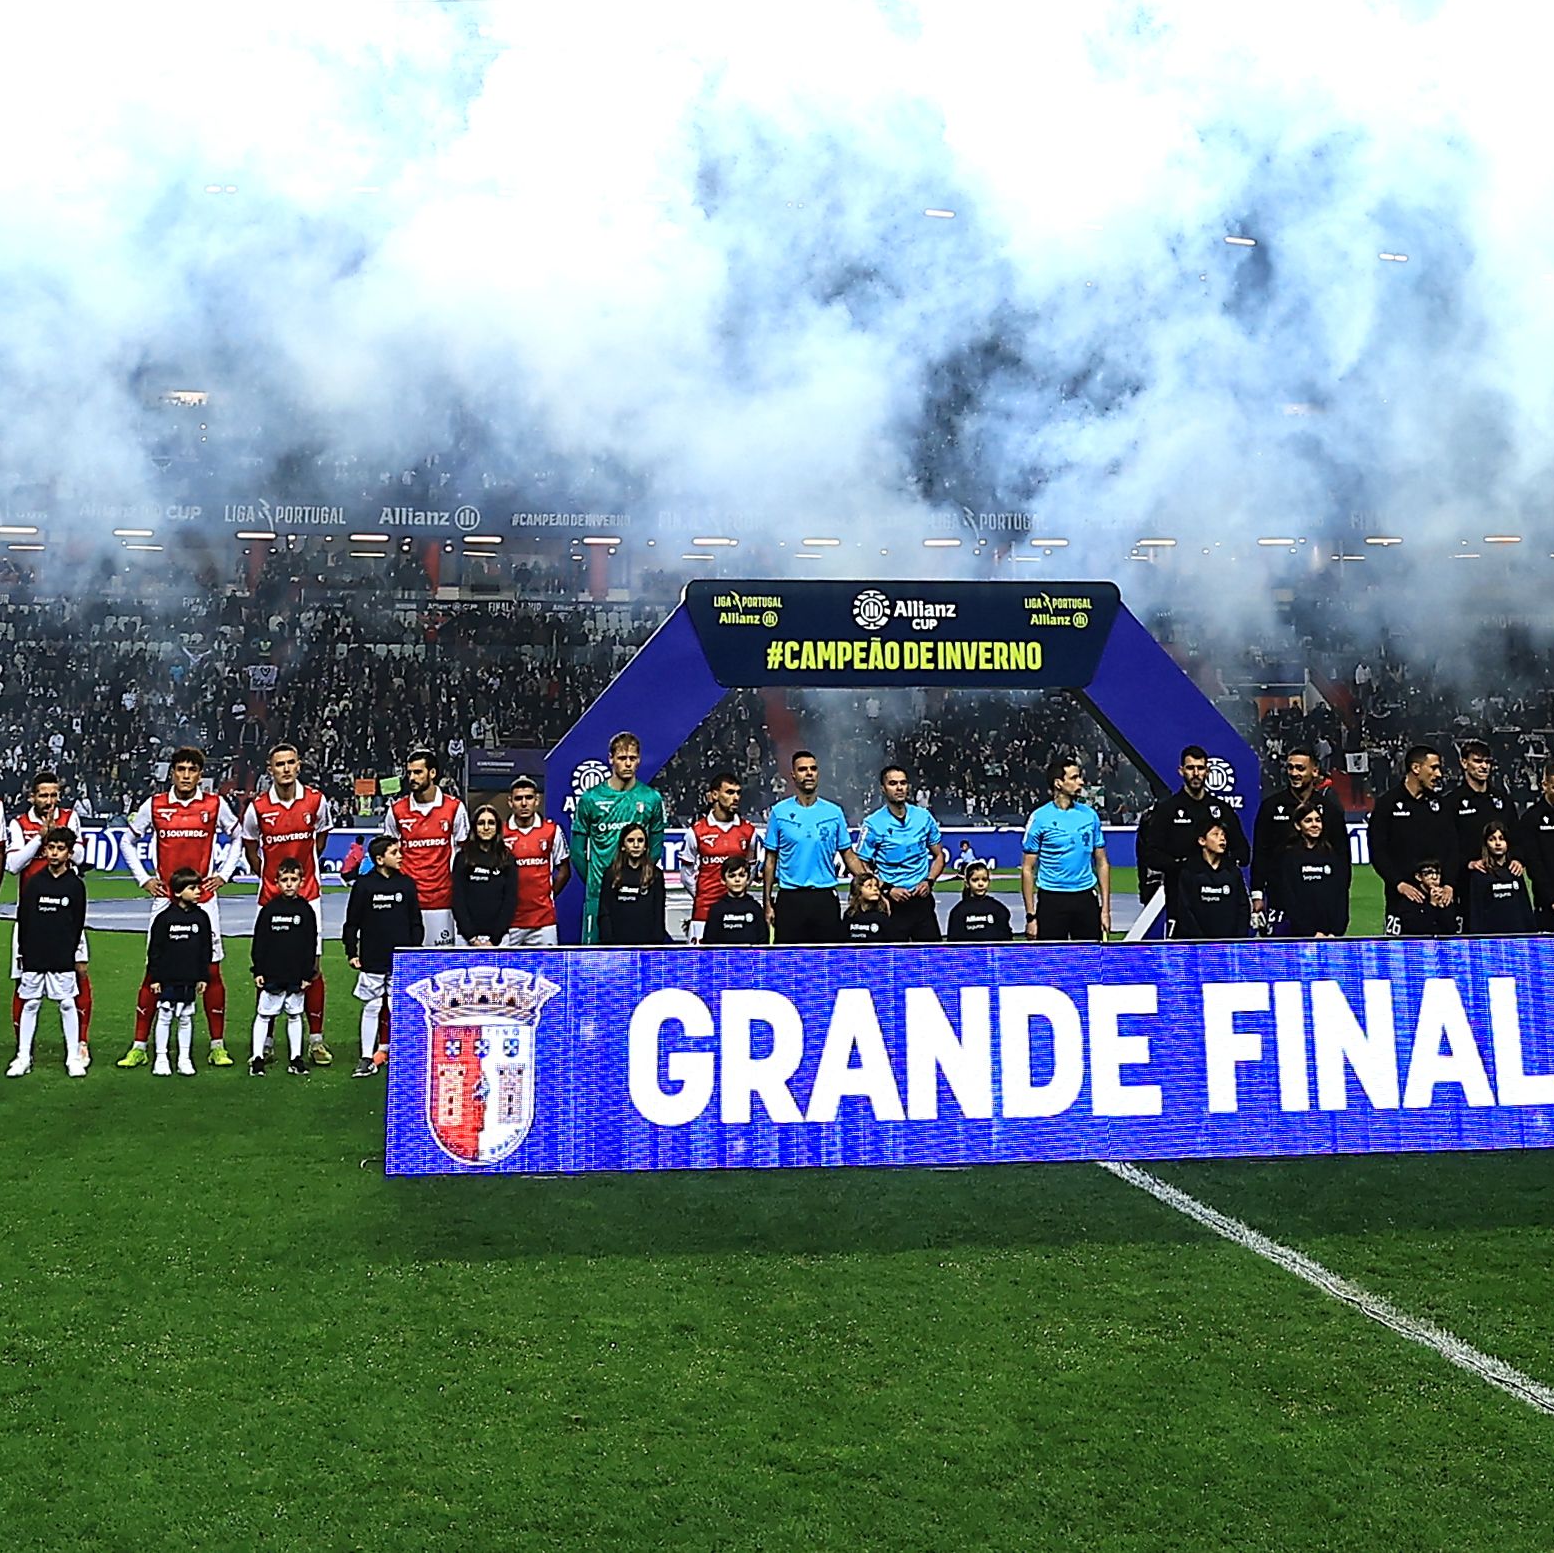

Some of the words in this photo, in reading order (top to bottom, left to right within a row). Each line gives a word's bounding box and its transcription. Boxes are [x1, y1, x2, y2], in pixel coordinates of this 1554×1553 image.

[166, 505, 203, 522] CUP
[224, 504, 256, 524] LIGA
[275, 506, 347, 526] PORTUGAL
[378, 507, 451, 526] Allianz
[714, 596, 732, 608] LIGA
[742, 596, 783, 608] PORTUGAL
[894, 600, 957, 618] Allianz
[1024, 598, 1043, 609] LIGA
[1052, 598, 1092, 610] PORTUGAL
[719, 613, 760, 625] Allianz
[911, 618, 938, 630] CUP
[1030, 613, 1071, 626] Allianz
[766, 636, 900, 670] #CAMPEÃO
[903, 641, 935, 670] DE
[937, 641, 1042, 671] INVERNO
[1167, 920, 1177, 938] 7
[1385, 914, 1403, 936] 26
[627, 982, 1163, 1127] GRANDE
